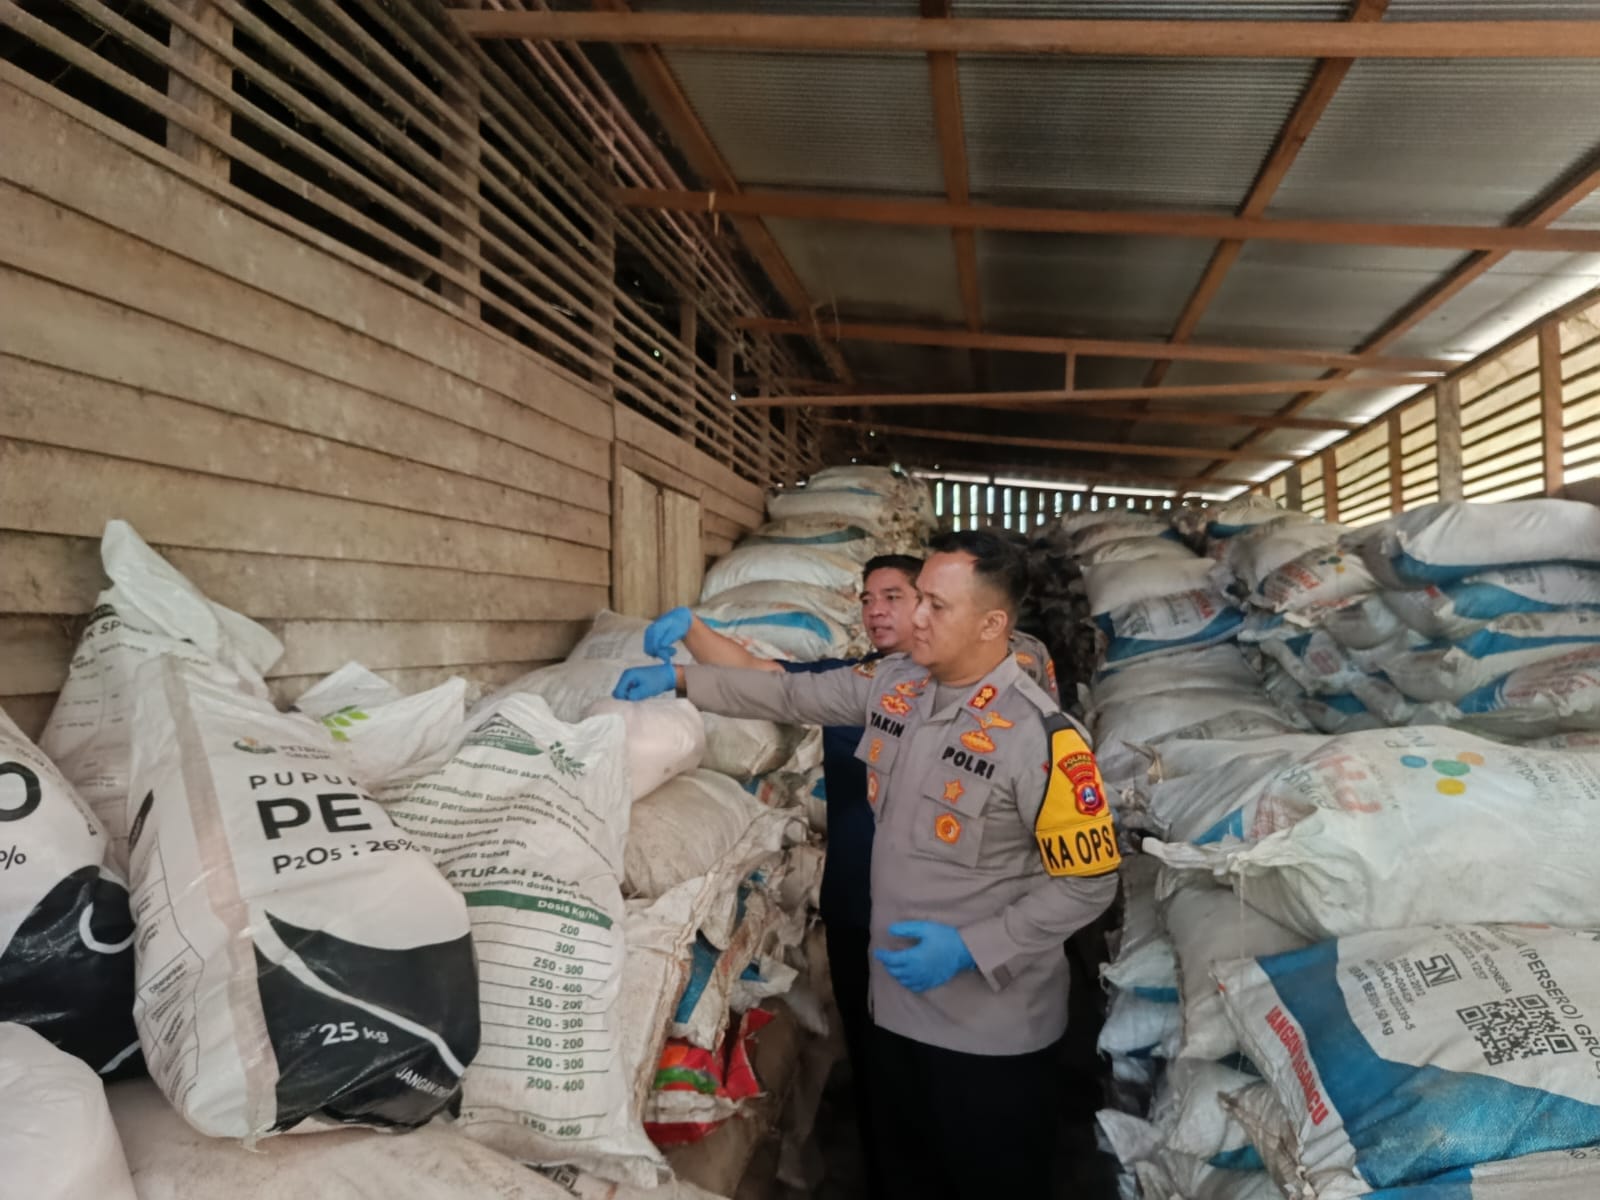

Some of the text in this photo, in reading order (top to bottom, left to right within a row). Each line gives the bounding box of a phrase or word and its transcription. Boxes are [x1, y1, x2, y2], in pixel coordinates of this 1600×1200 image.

[870, 712, 904, 737] YAKIN
[942, 746, 995, 779] POLRI
[1041, 825, 1115, 870] KA OPS
[446, 865, 527, 879] ATURAN
[537, 899, 572, 914] Dosis
[560, 923, 580, 937] 200
[554, 942, 576, 955] 300
[533, 957, 557, 971] 250
[565, 963, 584, 976] 300
[1418, 953, 1459, 988] SNI
[529, 976, 554, 990] 250
[562, 981, 583, 993] 400
[1520, 948, 1584, 1020] (PERSERO)
[528, 996, 552, 1010] 150
[562, 999, 583, 1010] 200
[527, 1015, 552, 1029] 200
[562, 1018, 584, 1030] 300
[1382, 1020, 1395, 1036] kg
[319, 1021, 360, 1046] 25
[362, 1027, 389, 1044] kg
[527, 1035, 552, 1048] 100
[562, 1038, 584, 1049] 200
[527, 1055, 552, 1069] 200
[564, 1058, 584, 1069] 300
[526, 1077, 552, 1090] 200
[564, 1078, 585, 1091] 400
[556, 1124, 582, 1136] 400
